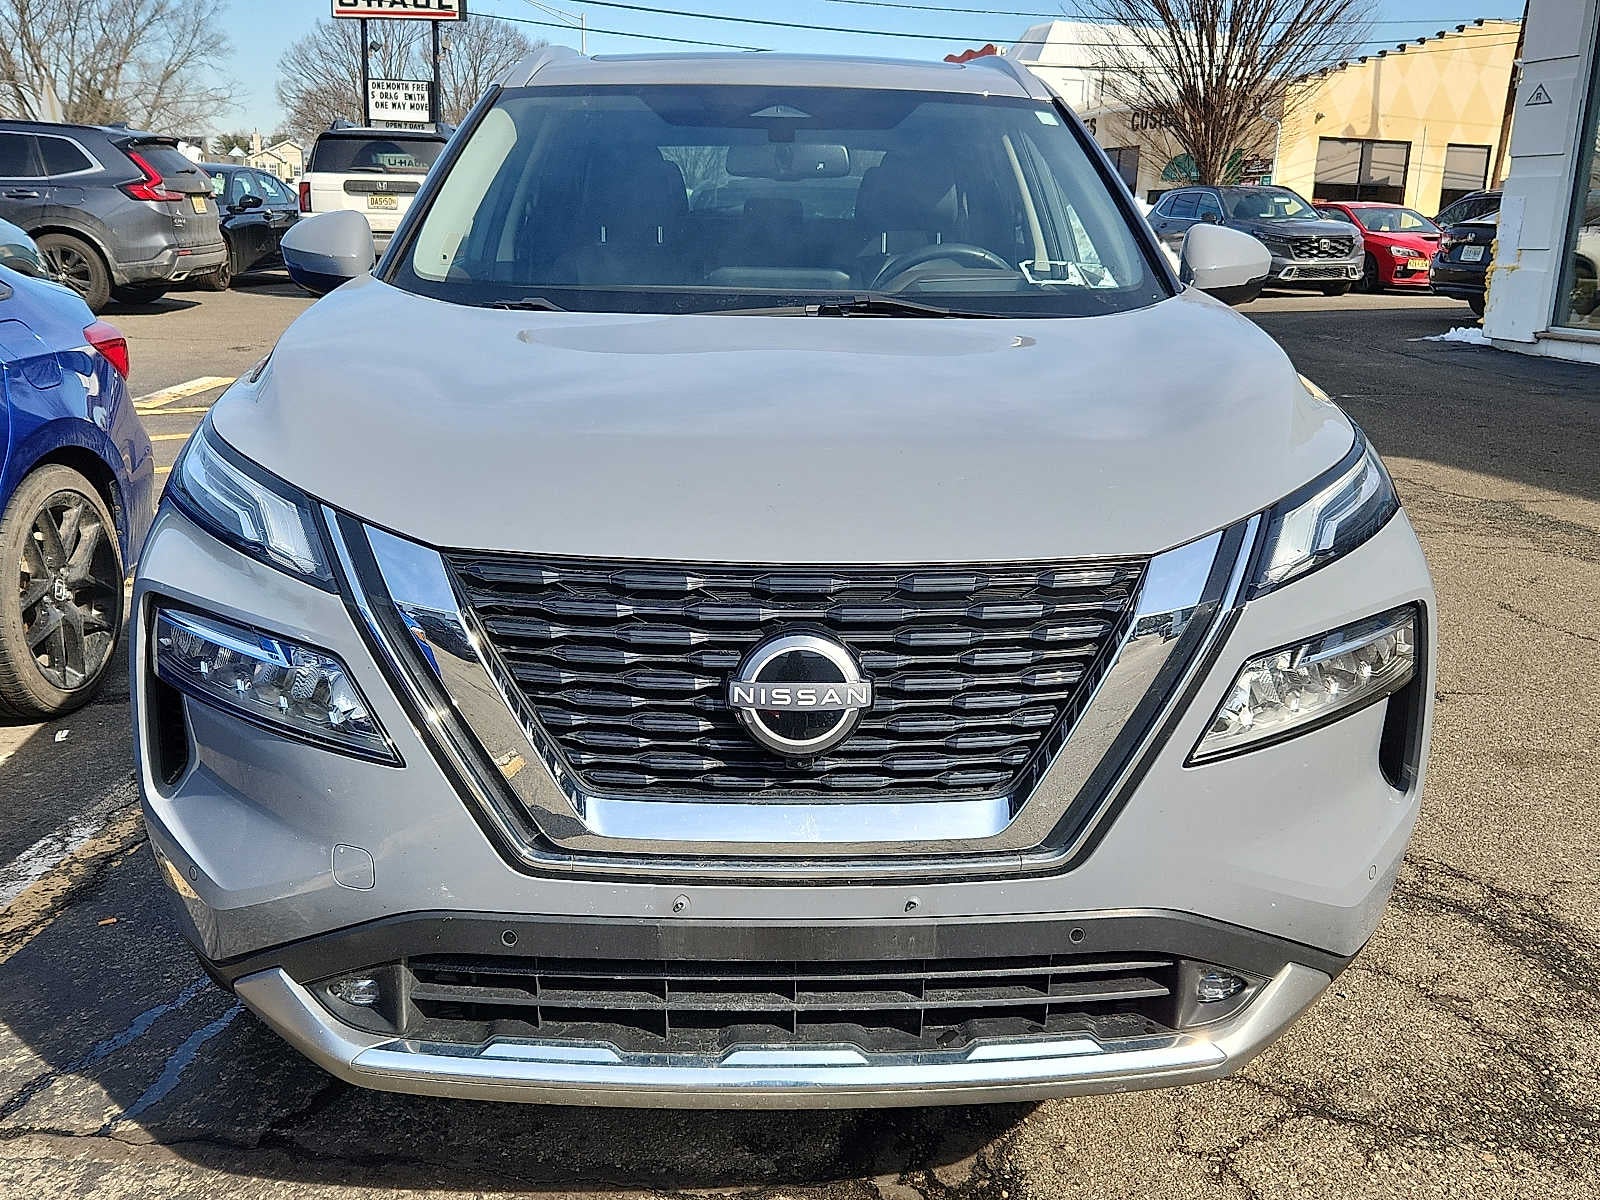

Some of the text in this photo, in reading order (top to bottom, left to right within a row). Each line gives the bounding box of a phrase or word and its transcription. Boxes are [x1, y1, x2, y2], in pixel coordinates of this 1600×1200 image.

[375, 101, 429, 111] ONE WAY MOVE
[385, 121, 403, 129] OPEN
[733, 687, 867, 706] NISSAN
